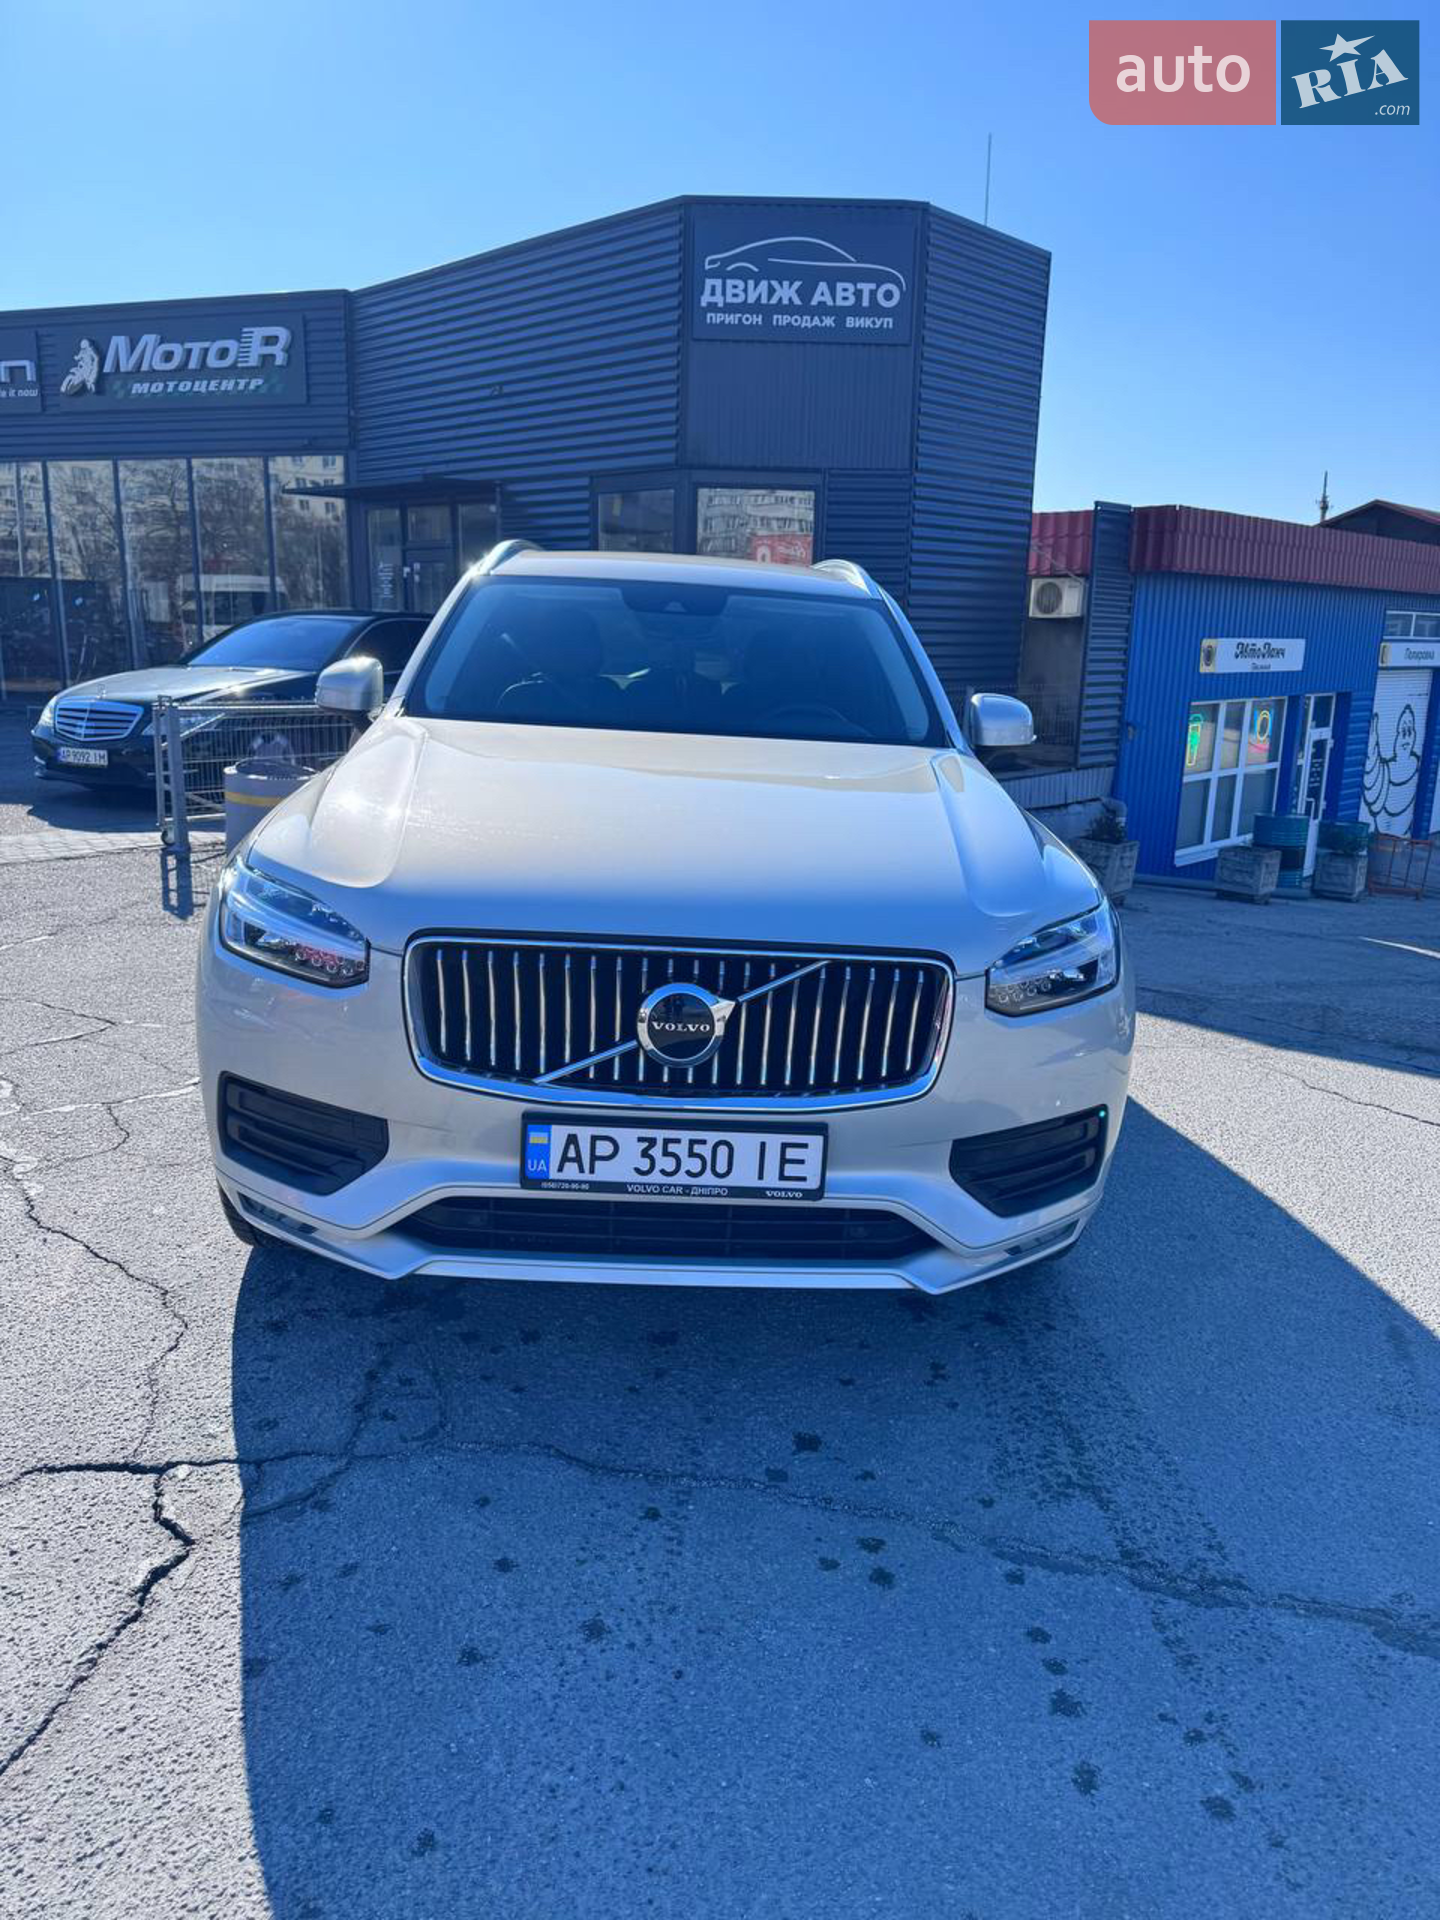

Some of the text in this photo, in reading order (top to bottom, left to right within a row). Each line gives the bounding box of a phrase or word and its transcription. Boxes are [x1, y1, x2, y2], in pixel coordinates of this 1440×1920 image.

[701, 278, 901, 308] ДВИЖ АВТО
[706, 312, 893, 329] ПРИГОН ПРОДАЖ ВИКУП
[131, 377, 264, 395] МОТОЦЕНТР
[652, 1021, 710, 1032] VOLVO
[557, 1133, 810, 1182] AP 3550 IE
[527, 1159, 547, 1172] UA
[626, 1184, 660, 1194] VOLVO
[662, 1185, 683, 1195] CAR
[690, 1186, 729, 1197] ДНІПРО
[765, 1190, 803, 1199] VOLVO
